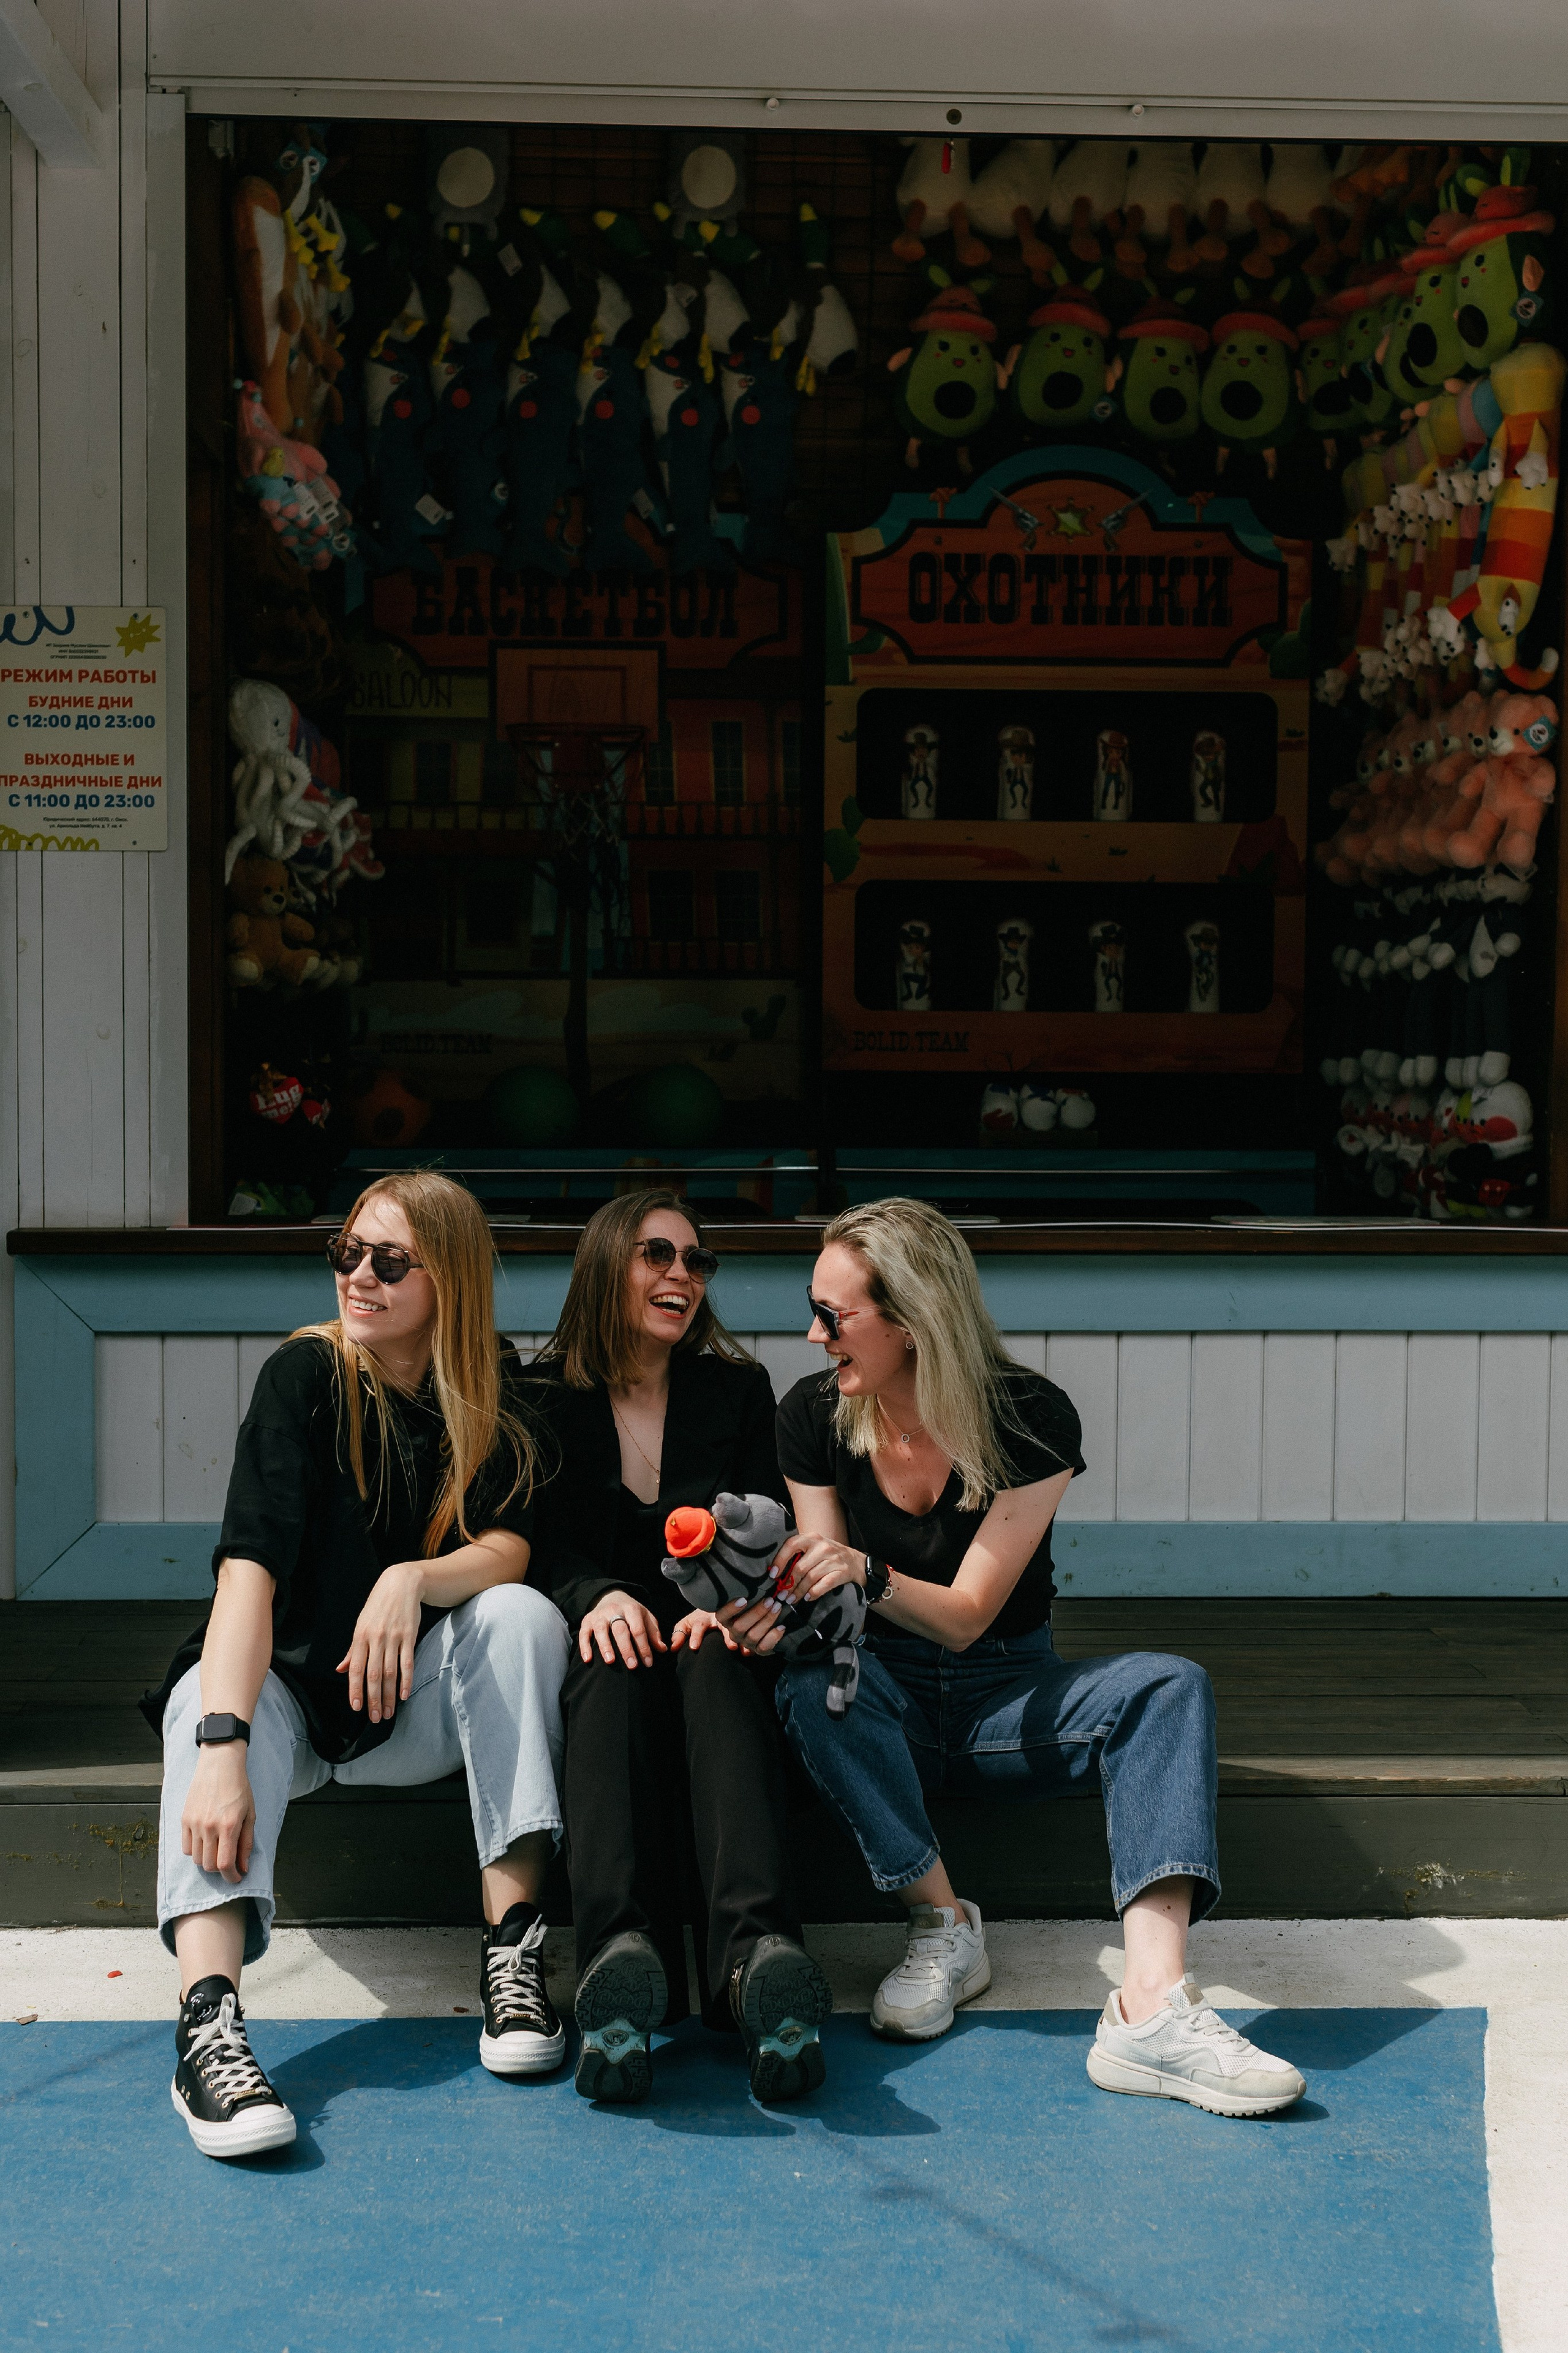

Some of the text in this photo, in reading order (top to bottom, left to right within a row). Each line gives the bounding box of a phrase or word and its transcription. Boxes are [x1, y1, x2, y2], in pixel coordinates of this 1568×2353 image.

[909, 551, 1233, 627] ОХОТНИКИ
[411, 567, 739, 638] БАСКЕТБОЛ
[1, 668, 157, 684] РЕЖИМ РАБОТЫ
[351, 671, 452, 708] SALOON
[28, 695, 134, 710] БУДНИЕ ДНИ
[7, 714, 156, 730] С 12:00 ДО 23:00
[24, 753, 134, 767] ВЫХОДНЫЕ И
[0, 775, 162, 790] ПРАЗДНИЧНЫЕ ДНИ
[9, 794, 155, 809] С 11:00 ДО 23:00
